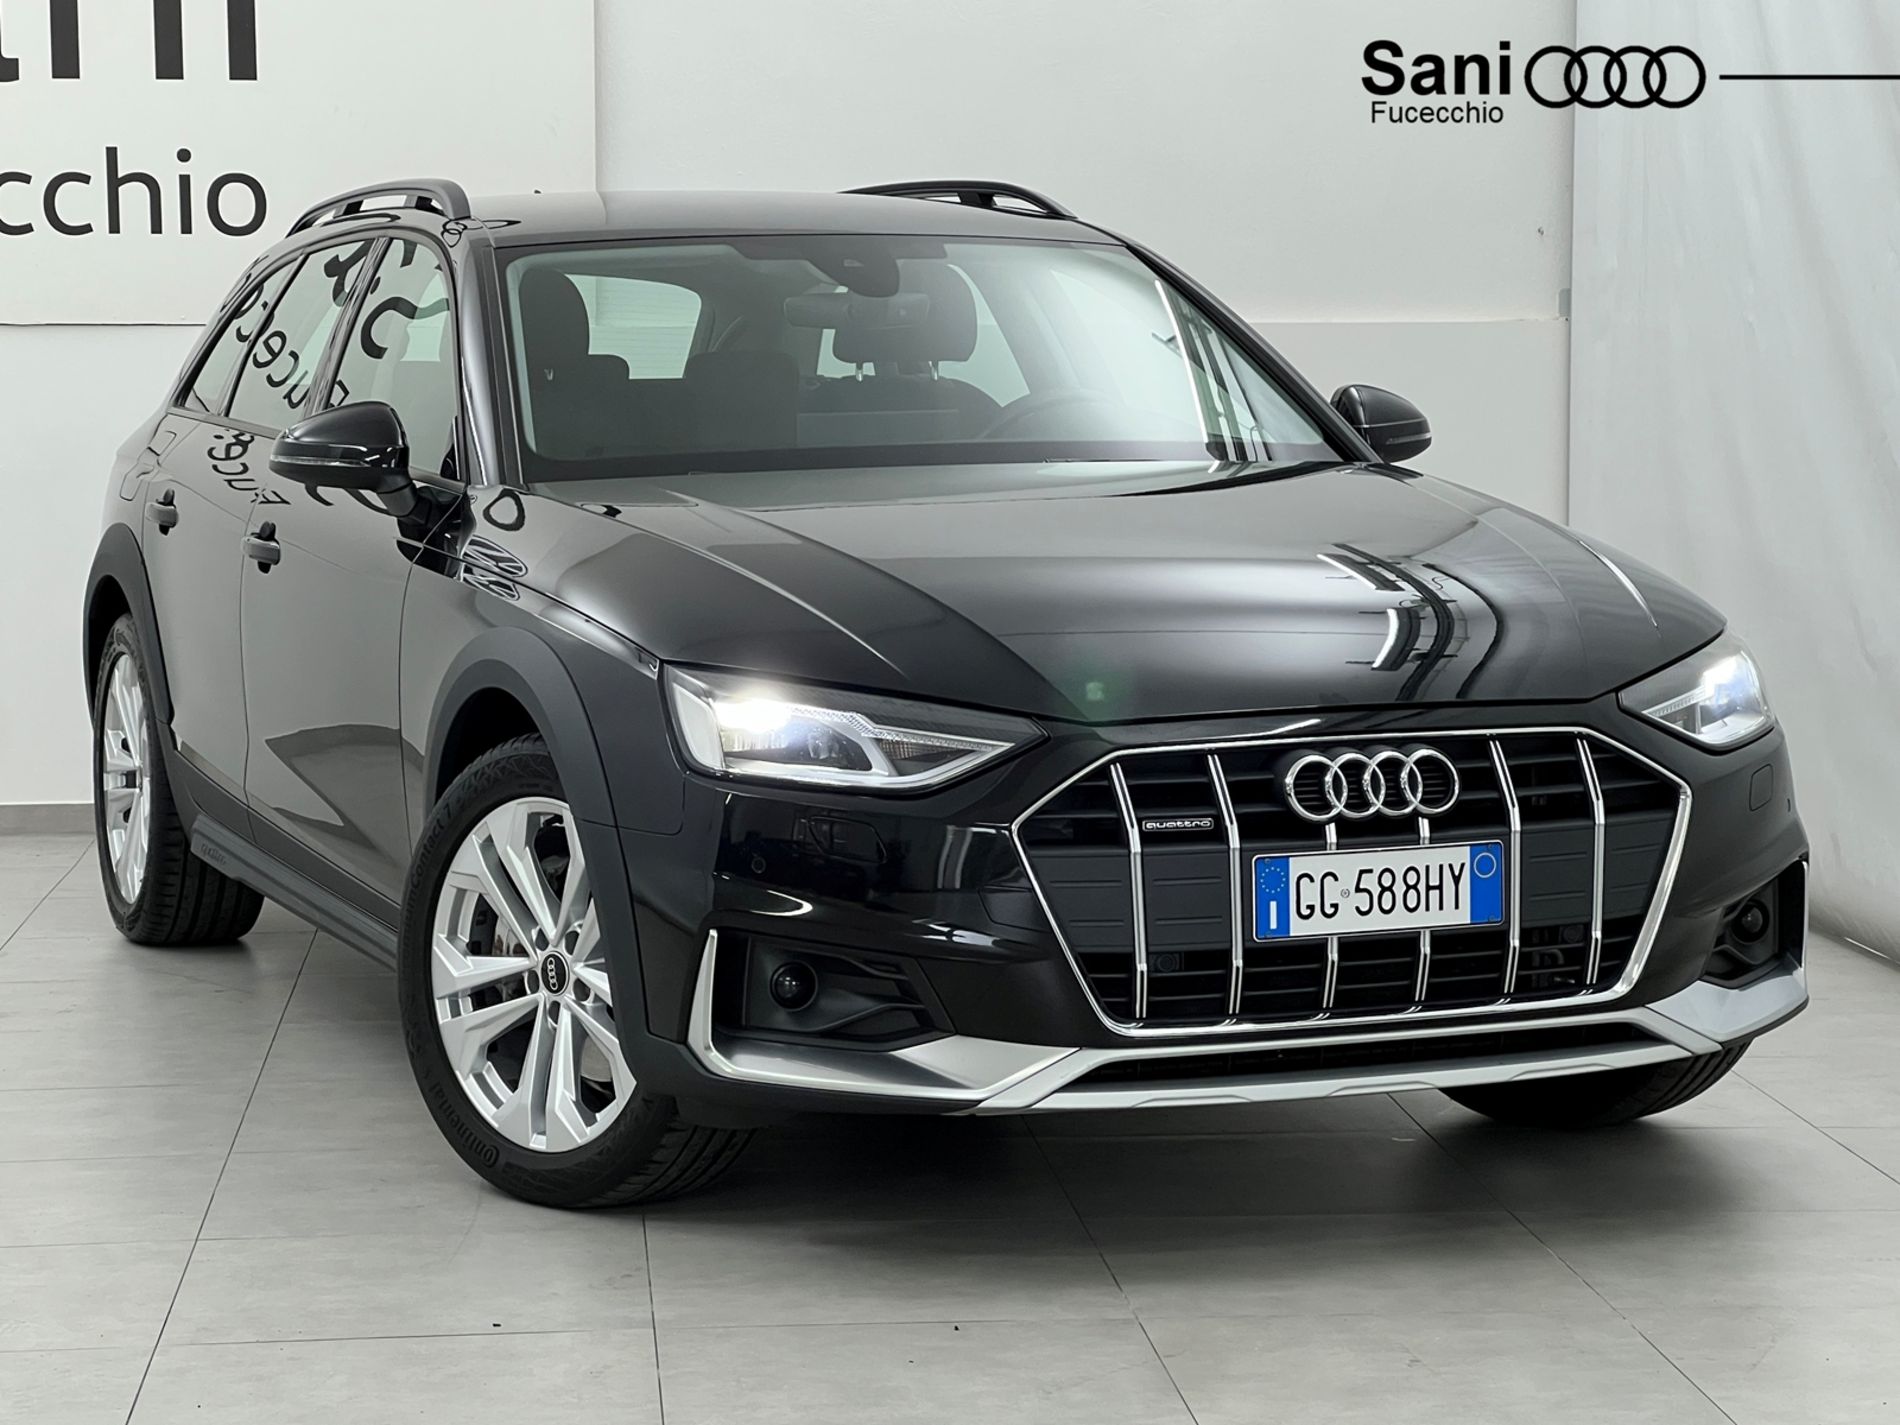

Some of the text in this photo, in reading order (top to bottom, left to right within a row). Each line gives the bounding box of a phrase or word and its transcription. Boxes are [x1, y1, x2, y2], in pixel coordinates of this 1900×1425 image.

[1145, 820, 1211, 830] quattro
[1295, 862, 1466, 920] GG 588HY
